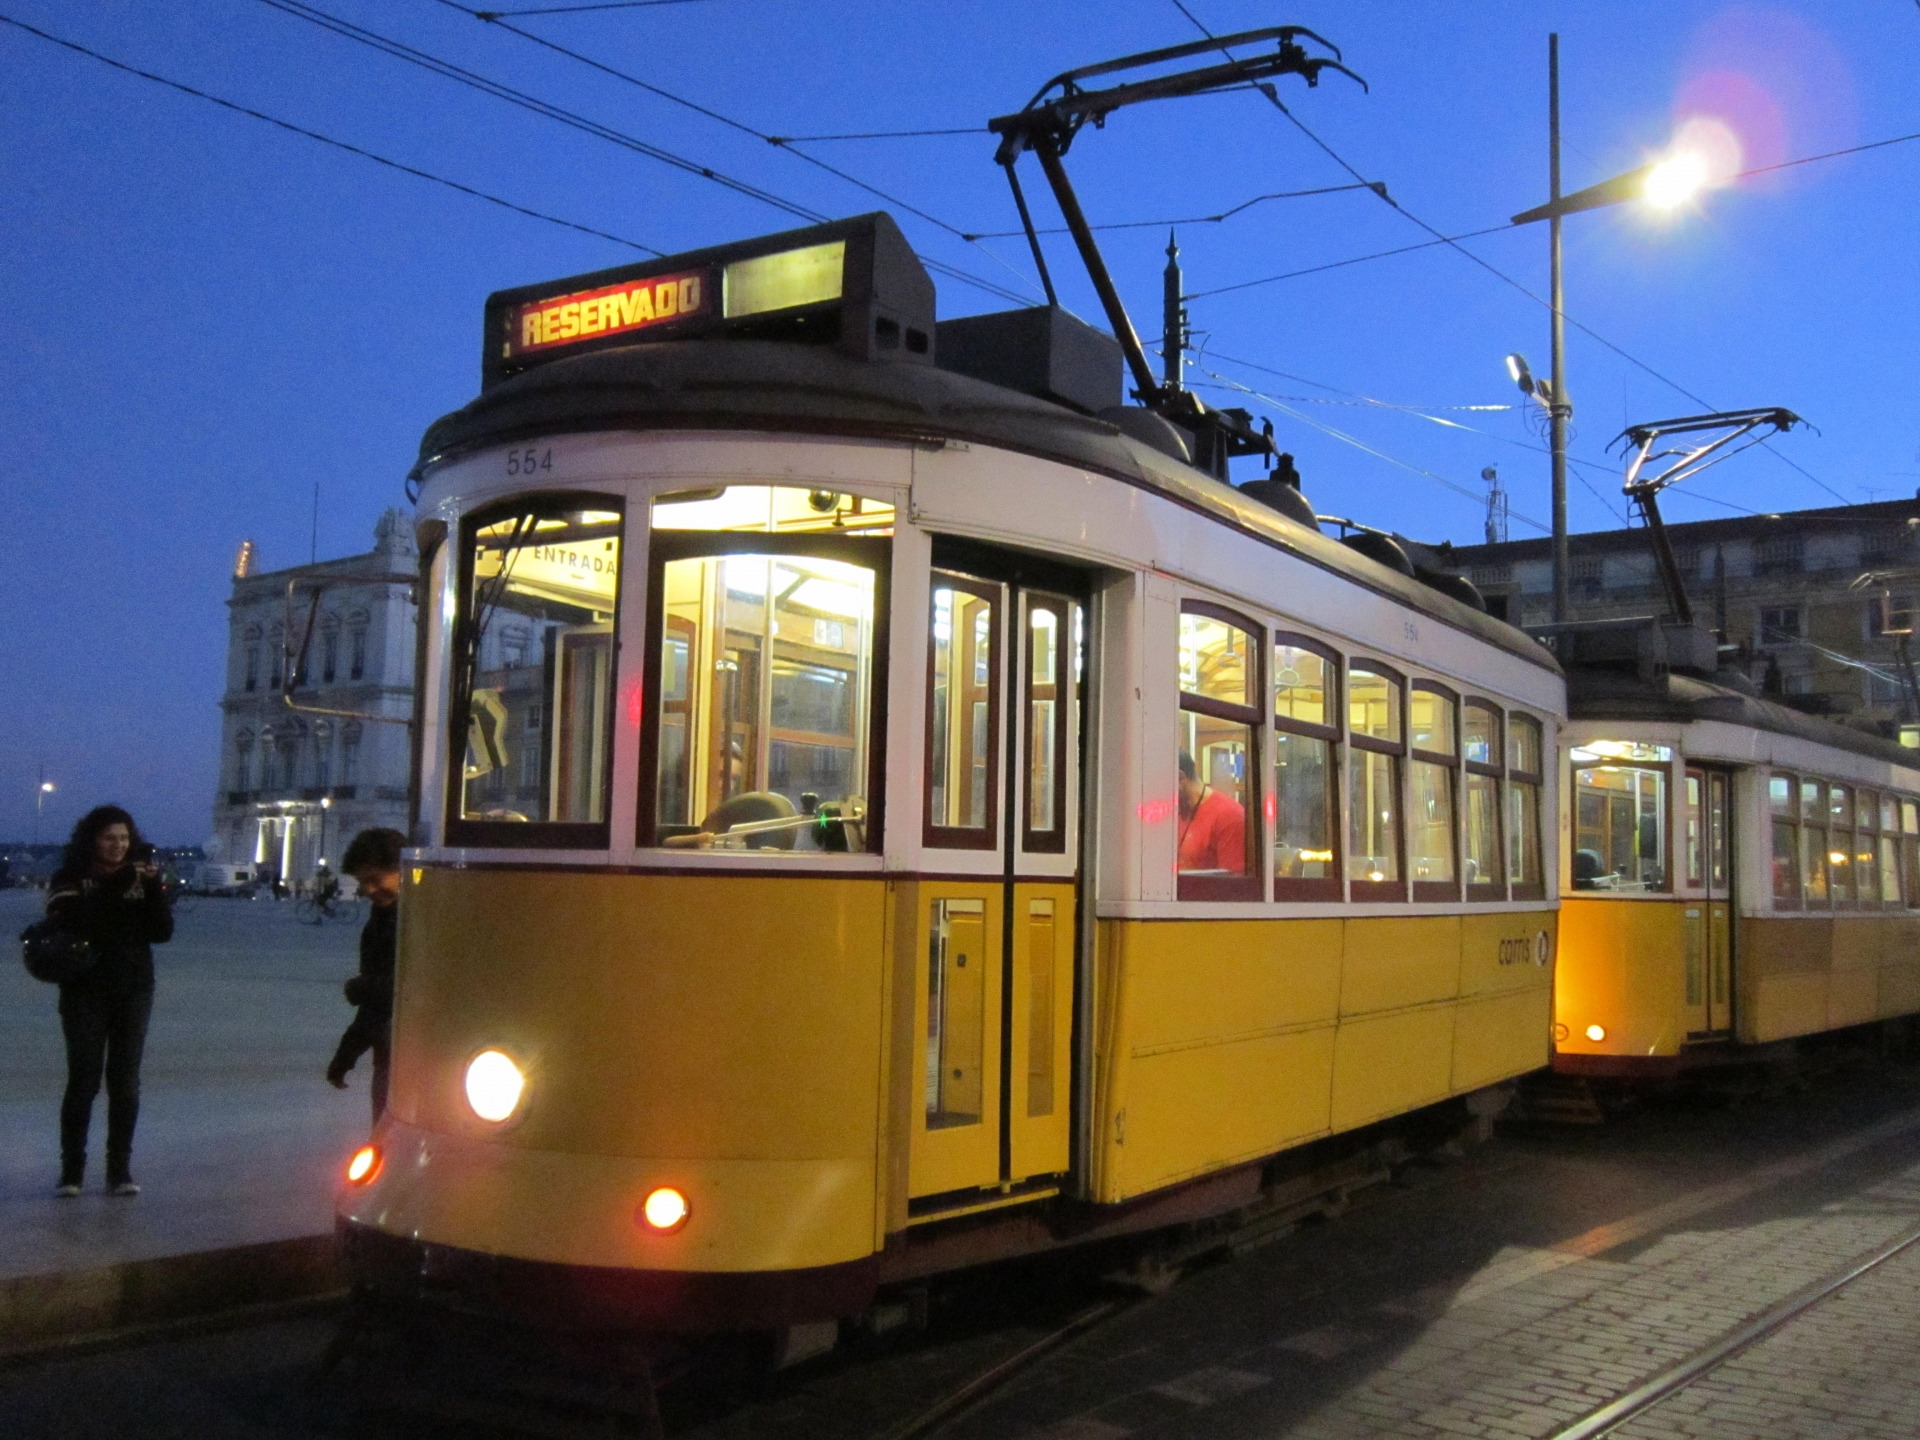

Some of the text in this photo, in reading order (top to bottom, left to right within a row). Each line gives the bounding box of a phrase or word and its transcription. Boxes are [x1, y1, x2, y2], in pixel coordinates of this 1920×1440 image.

[522, 276, 701, 346] RESERVADO
[507, 449, 552, 476] 554
[534, 546, 616, 575] ENTRADA
[1499, 927, 1530, 965] carris
